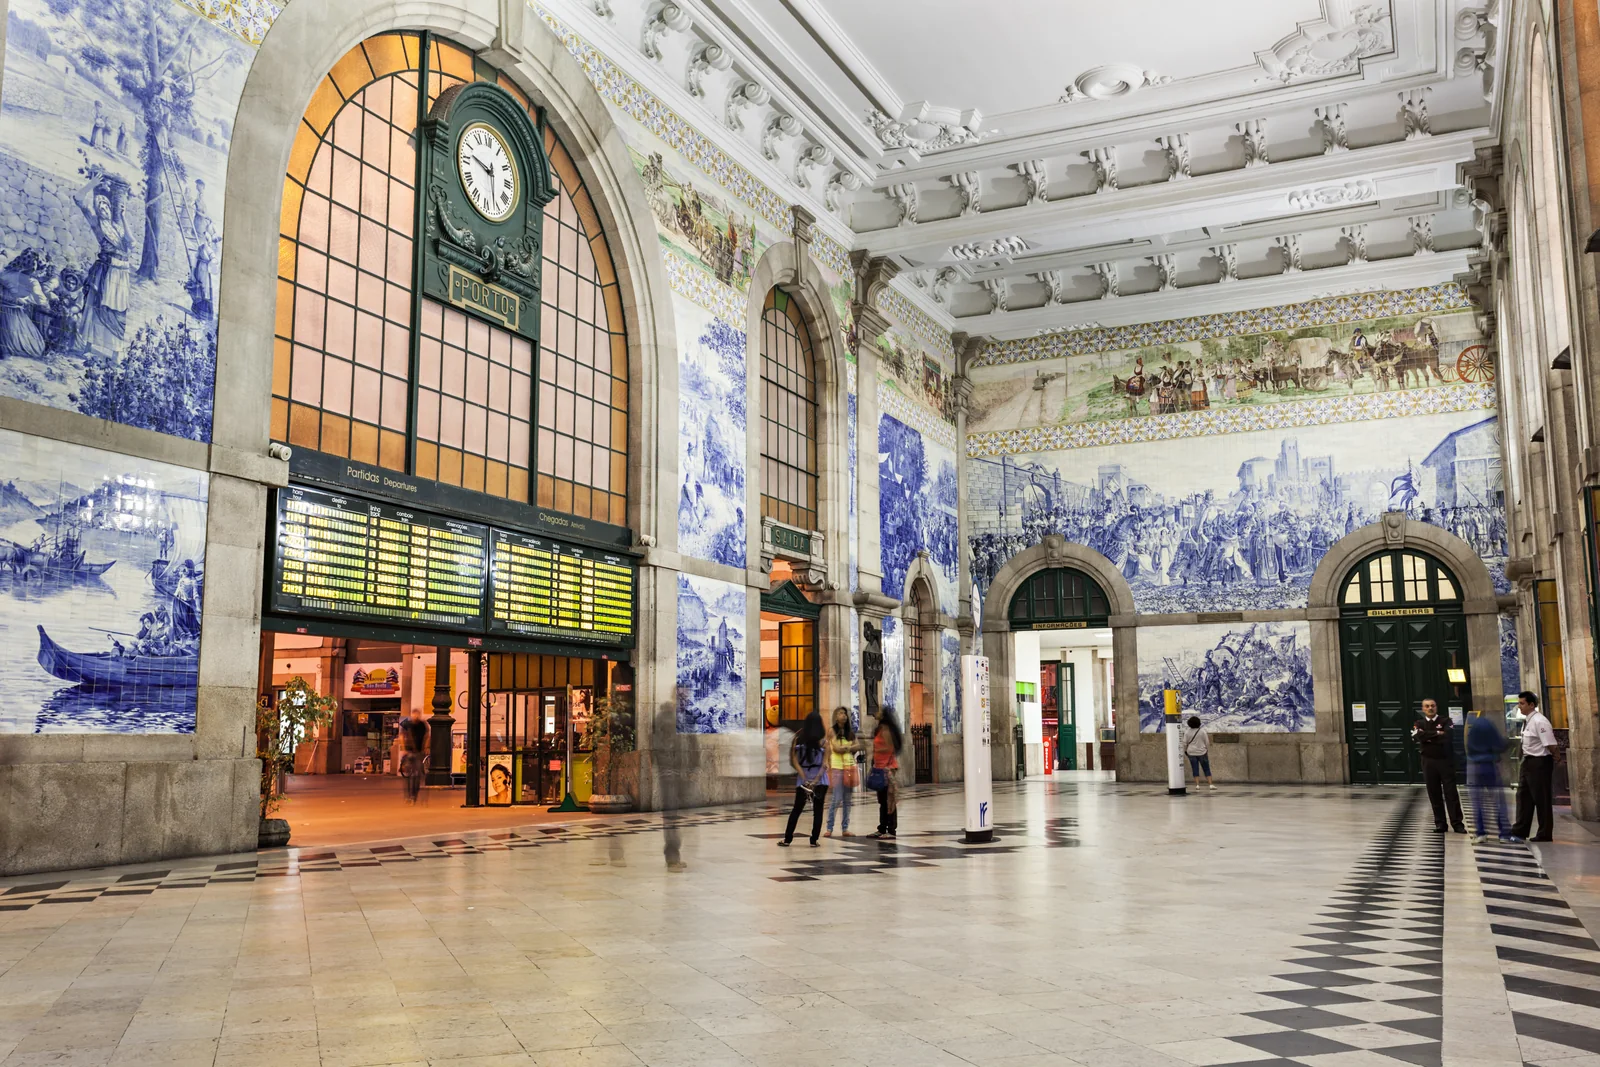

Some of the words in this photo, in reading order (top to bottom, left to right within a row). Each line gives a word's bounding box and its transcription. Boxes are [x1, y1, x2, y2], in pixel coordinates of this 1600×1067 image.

[461, 276, 509, 315] PORTO
[346, 466, 380, 484] Partidas
[383, 477, 418, 493] Departures
[539, 512, 569, 526] Chegadas
[283, 559, 304, 571] 22H55
[306, 562, 330, 574] AVEIRO
[282, 583, 303, 595] 23H20
[1371, 608, 1430, 616] BILHETEIRAS
